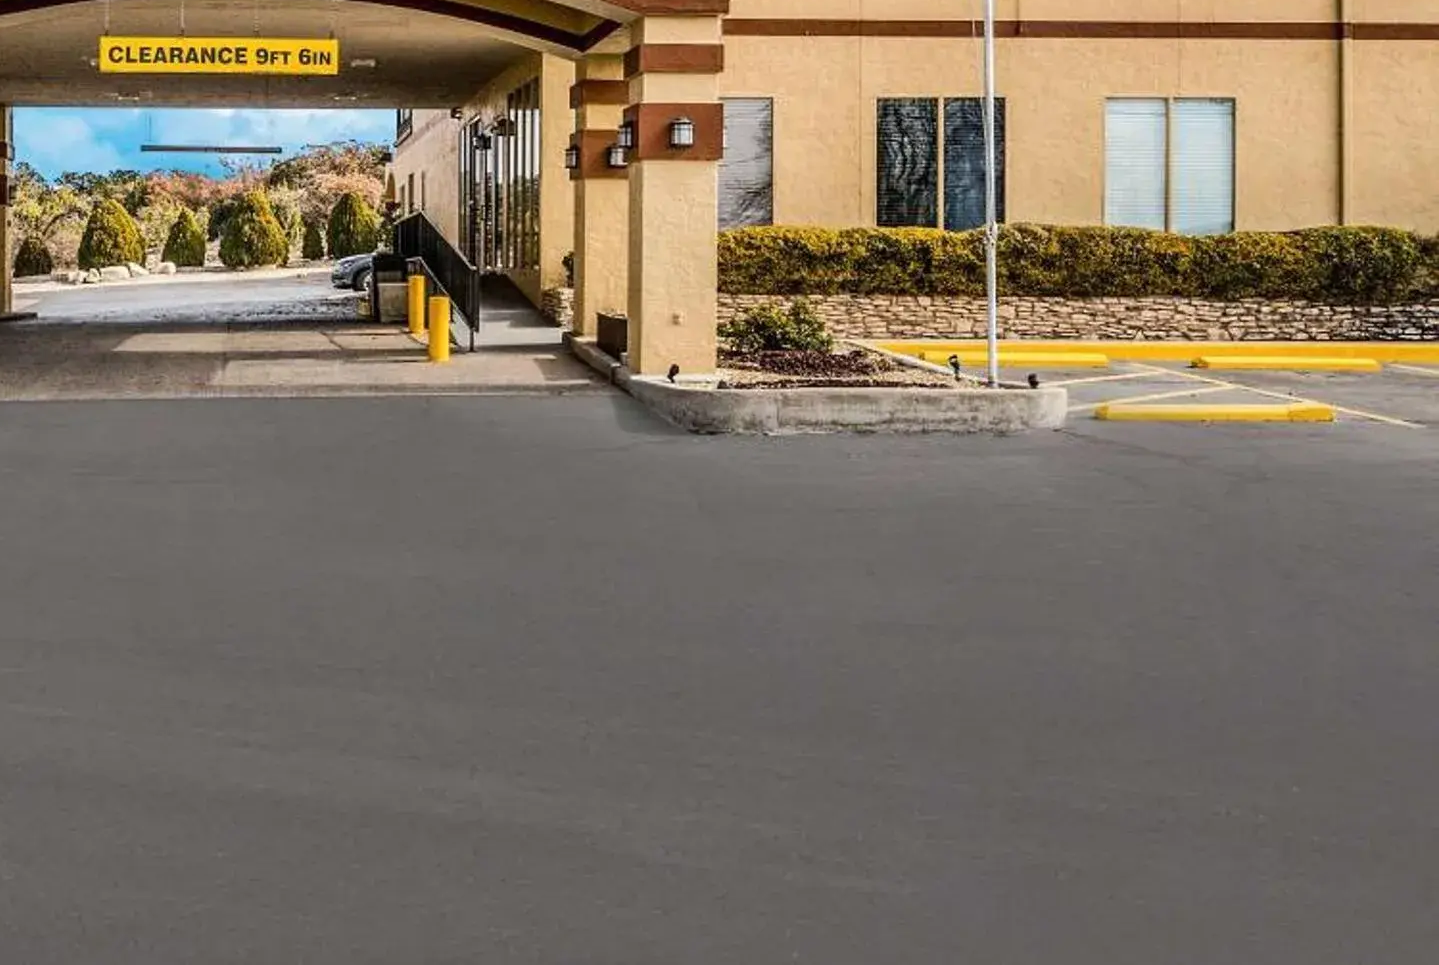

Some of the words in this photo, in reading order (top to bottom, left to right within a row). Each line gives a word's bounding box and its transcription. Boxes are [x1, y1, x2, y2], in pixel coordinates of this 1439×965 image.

[108, 46, 248, 65] CLEARANCE
[256, 48, 292, 65] 9FT
[298, 48, 331, 66] 6IN
